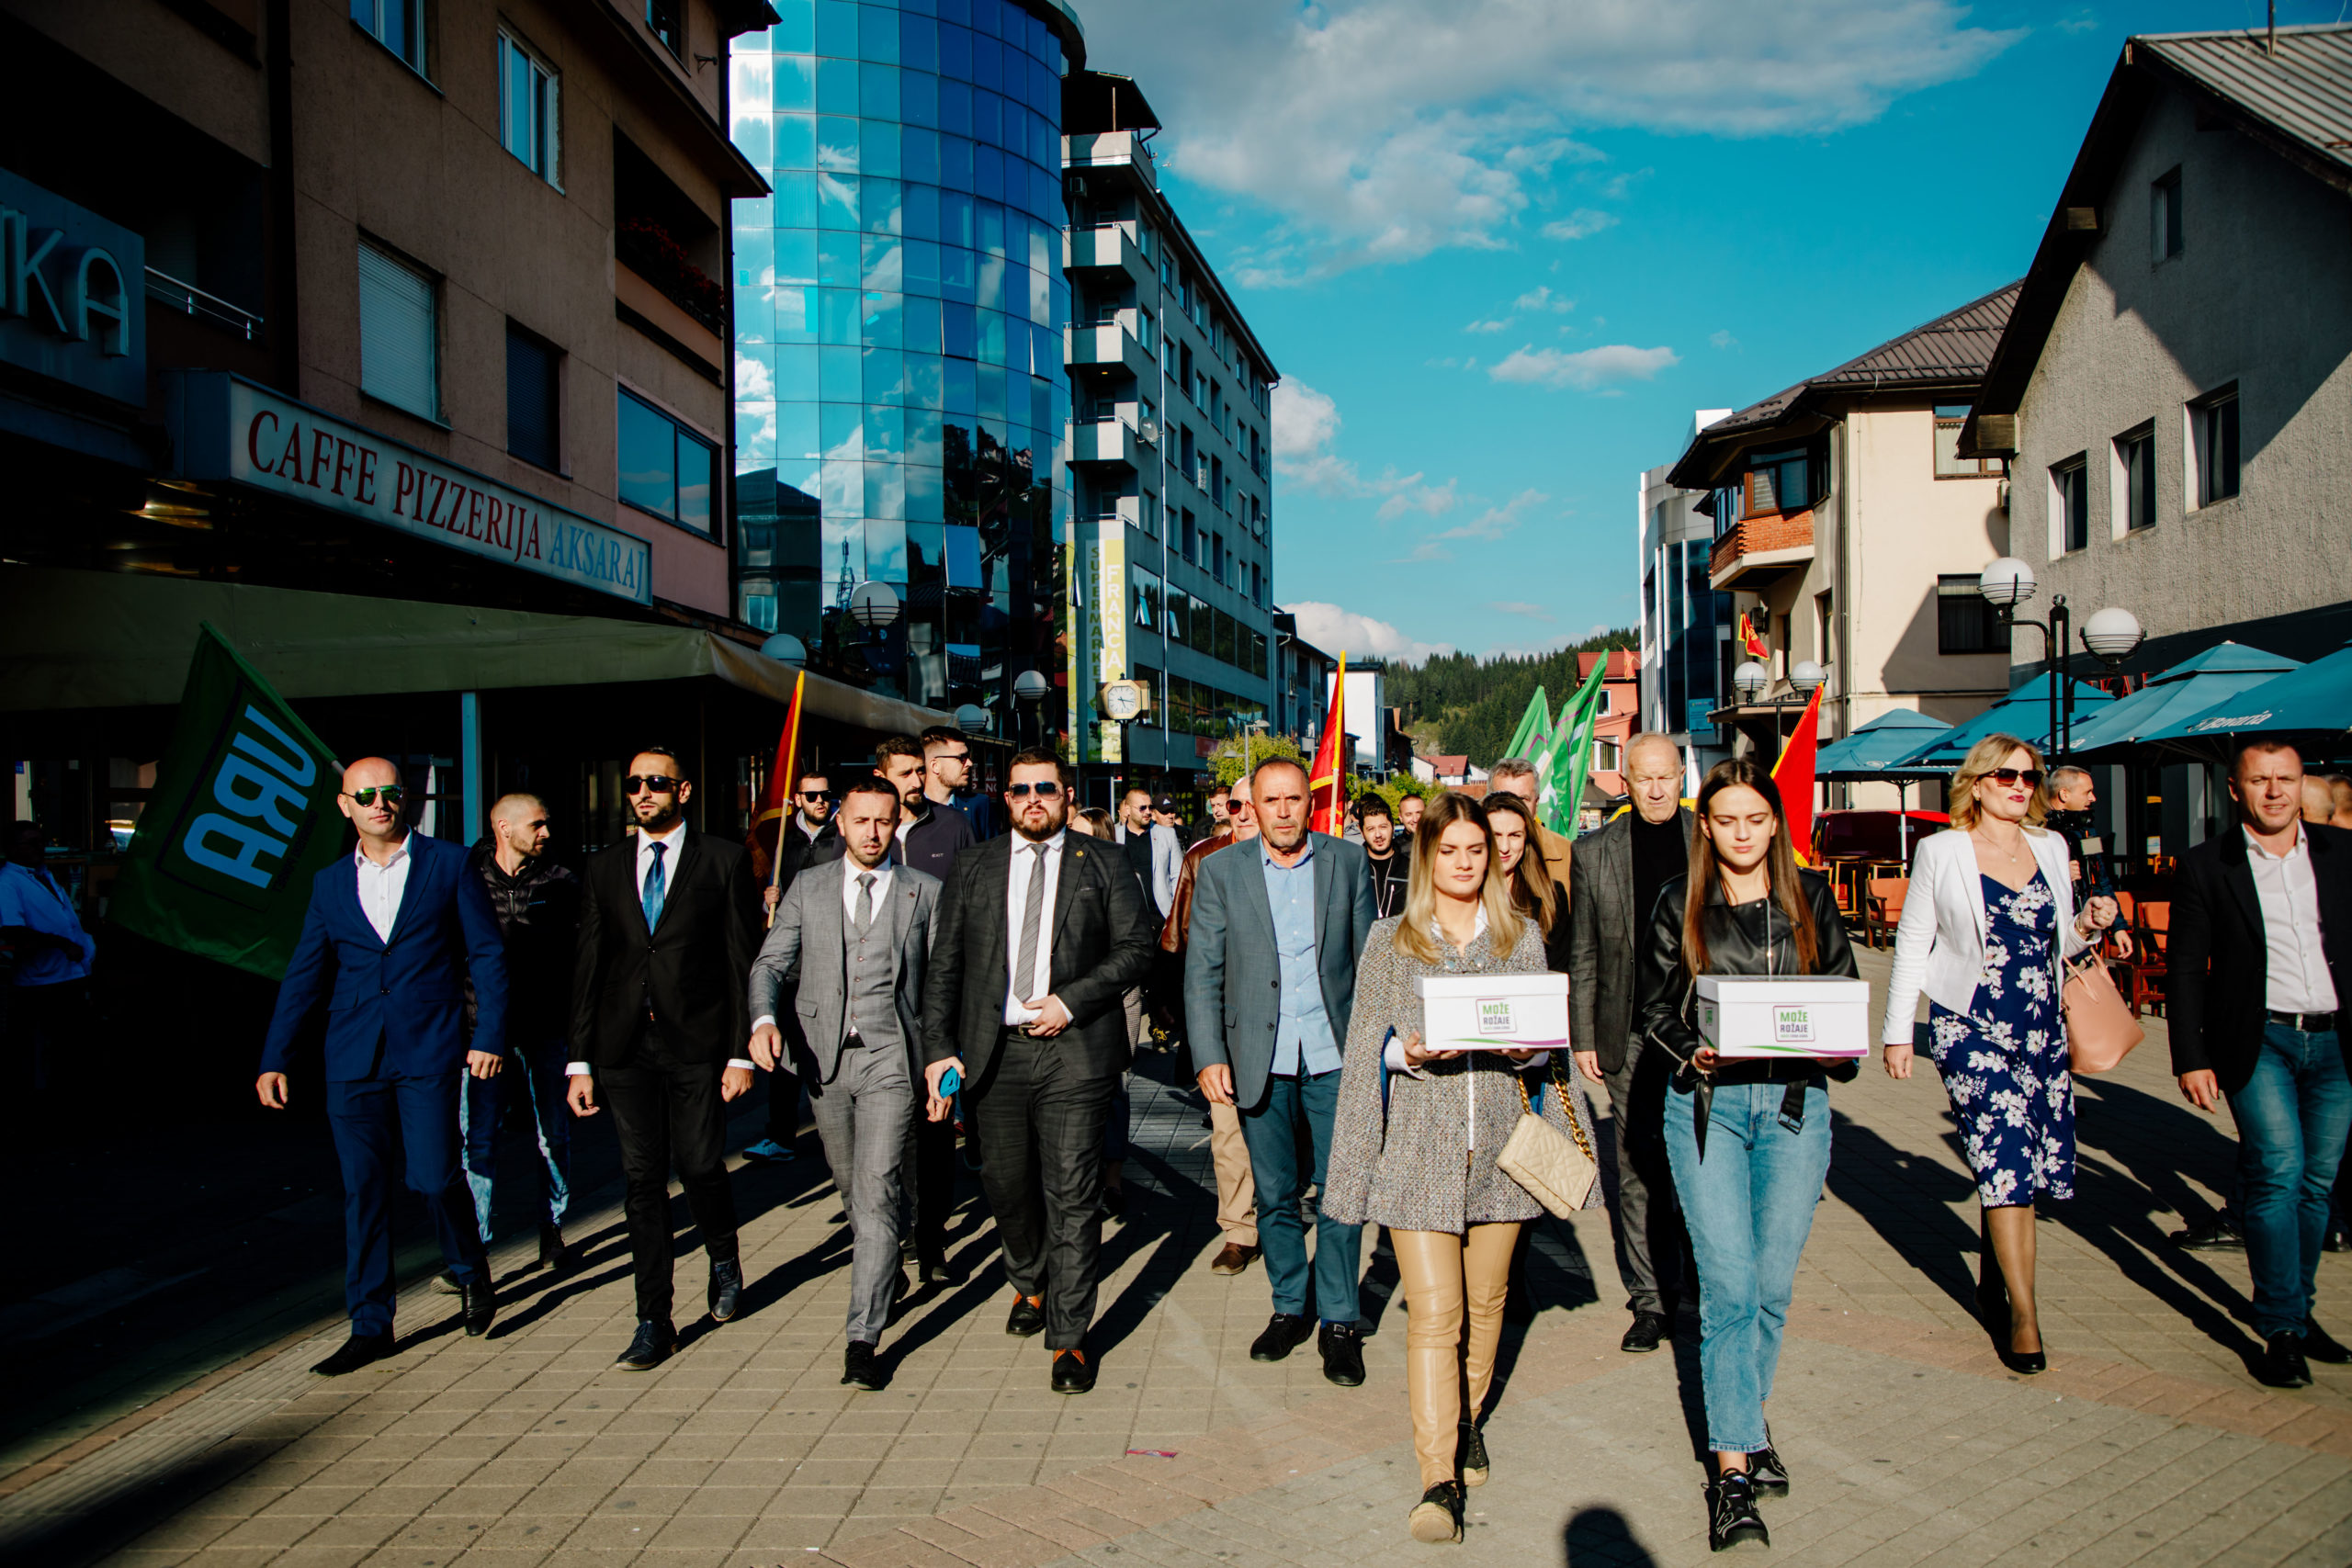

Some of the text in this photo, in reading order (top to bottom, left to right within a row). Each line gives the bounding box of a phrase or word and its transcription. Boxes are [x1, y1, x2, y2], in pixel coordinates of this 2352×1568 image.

[247, 410, 646, 598] CAFFE PIZZERIJA AKSARAJ
[1106, 564, 1123, 670] FRANCA
[1482, 1001, 1510, 1015] MOŽE
[1780, 1010, 1808, 1022] MOŽE
[1780, 1022, 1808, 1033] ROŽAJE
